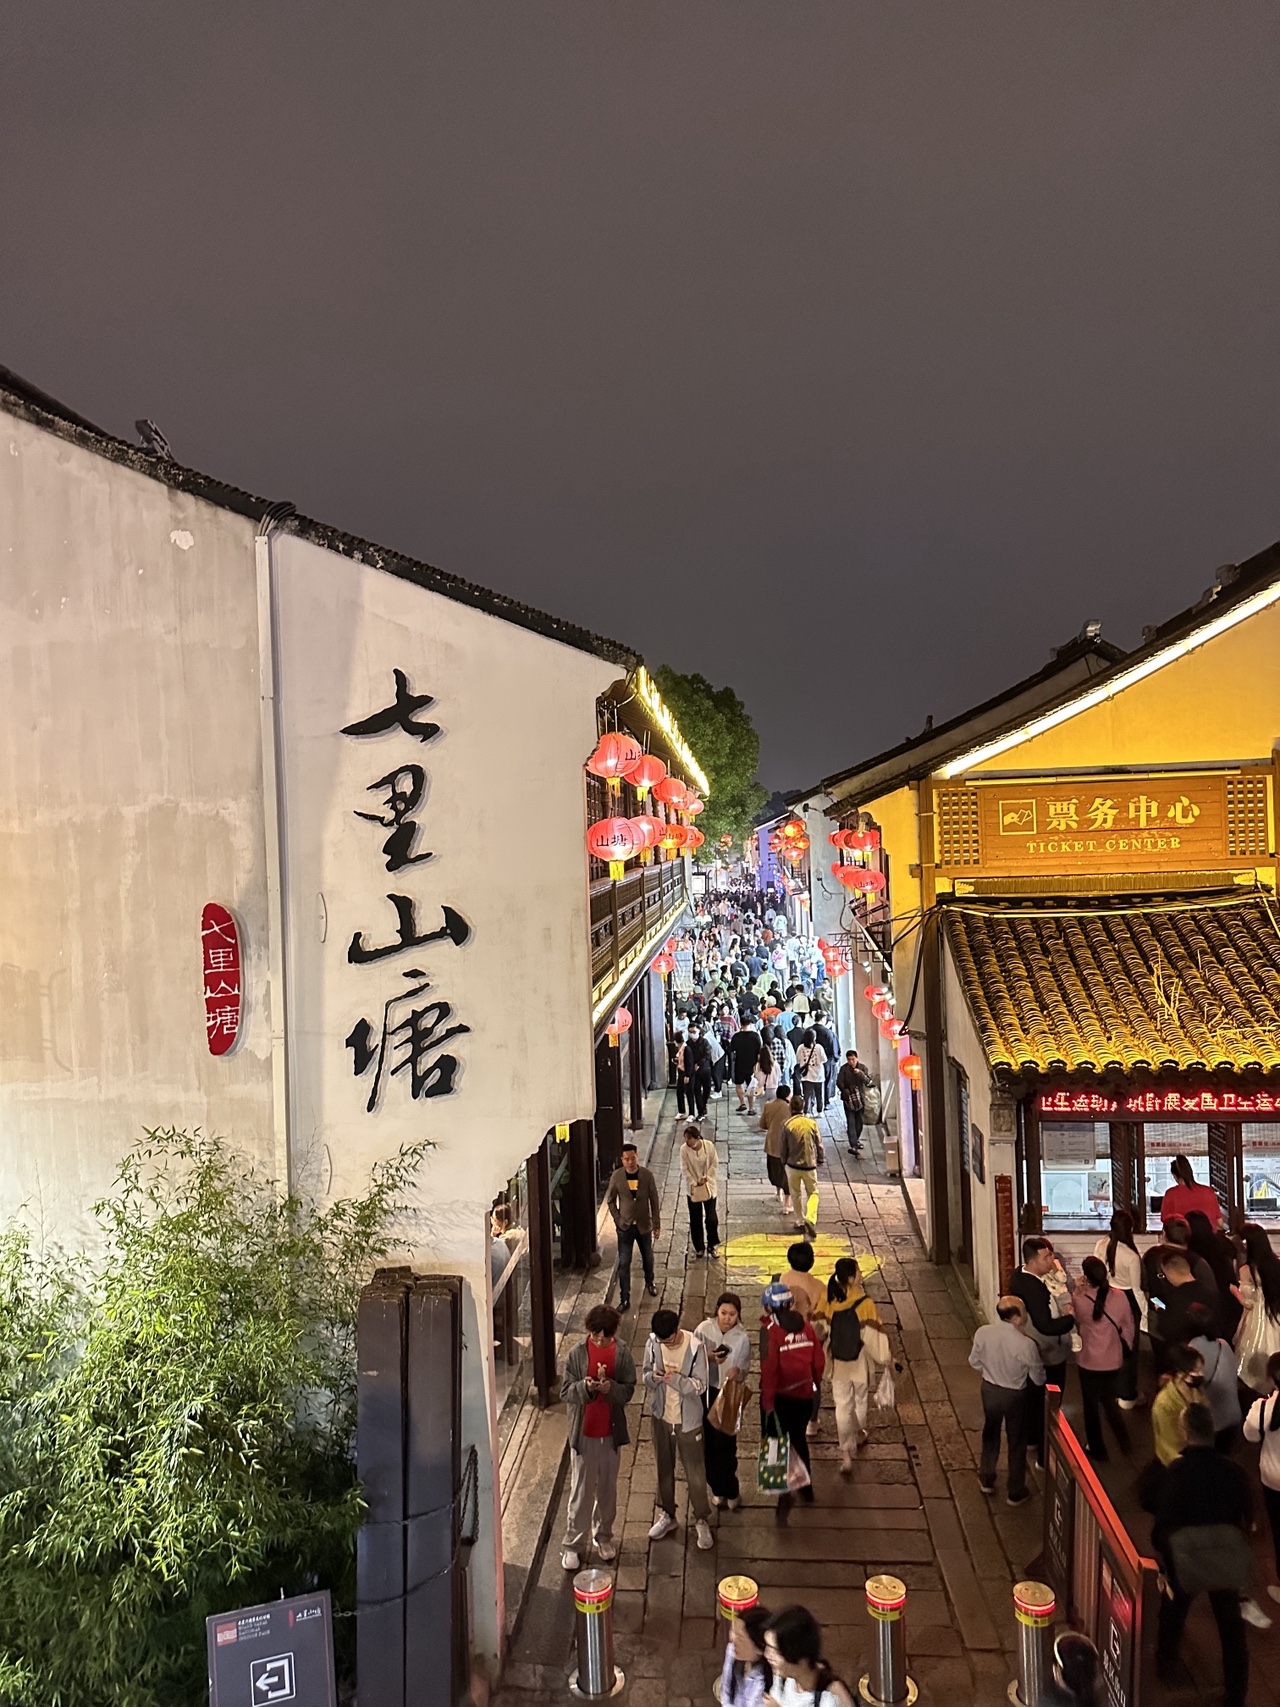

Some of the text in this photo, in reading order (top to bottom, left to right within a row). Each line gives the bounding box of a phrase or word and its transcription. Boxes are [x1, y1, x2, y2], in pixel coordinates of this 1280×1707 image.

[1046, 795, 1201, 831] 票务中心
[596, 833, 628, 847] 山塘
[1026, 836, 1181, 855] TICKET CENTER
[339, 668, 471, 1113] 七里山塘
